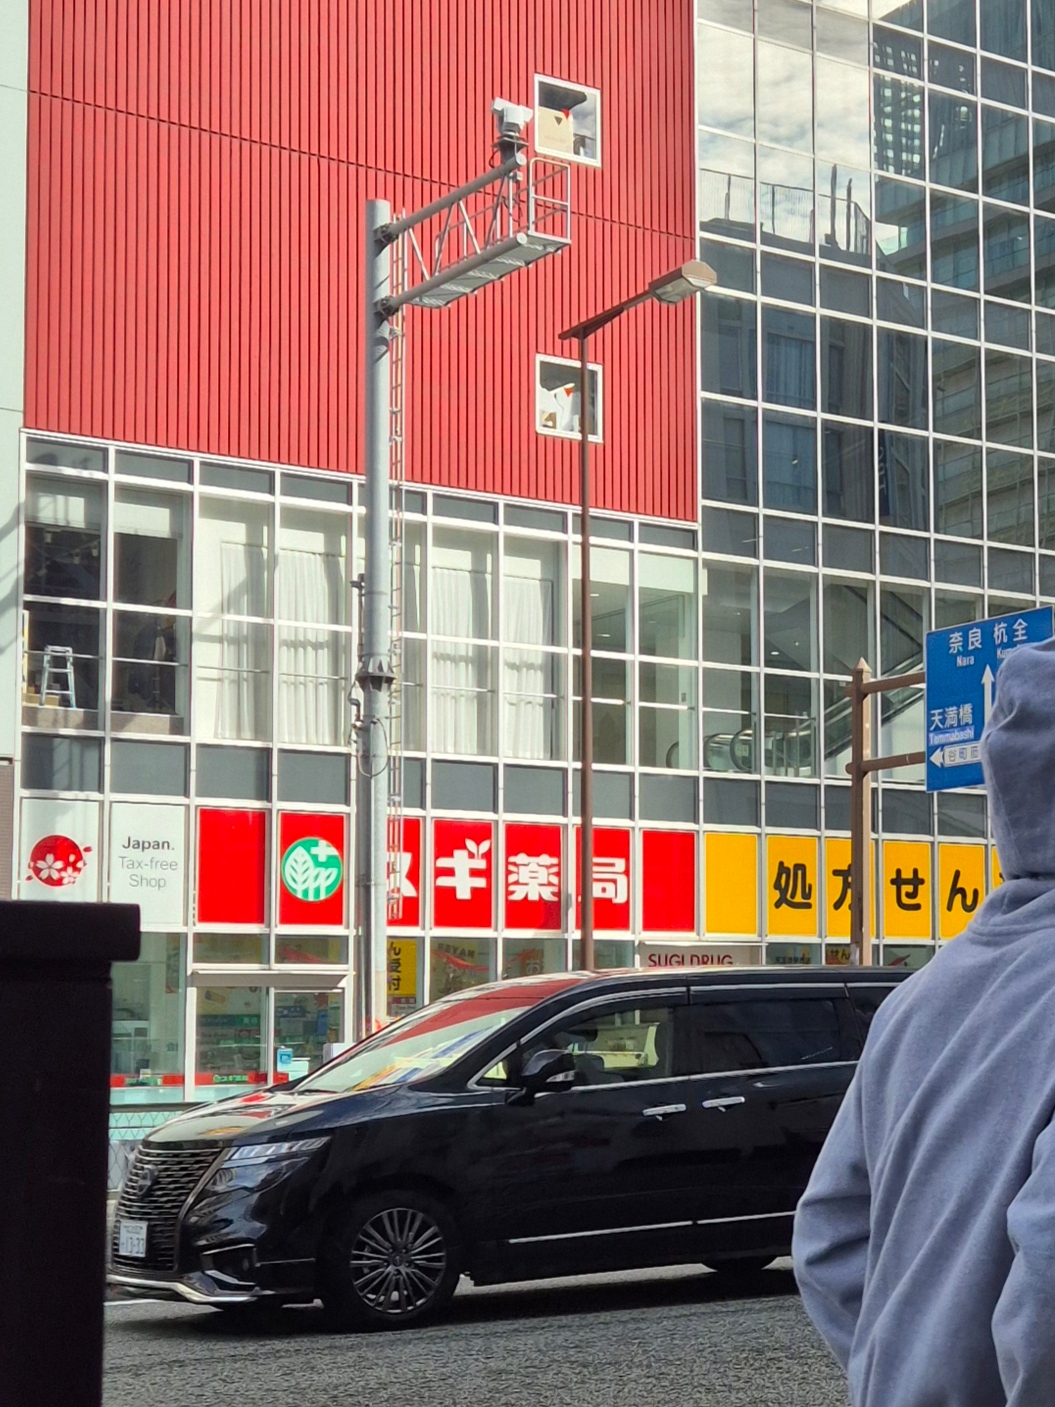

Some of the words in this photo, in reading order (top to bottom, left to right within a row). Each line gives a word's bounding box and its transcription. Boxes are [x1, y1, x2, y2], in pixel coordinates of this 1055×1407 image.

[949, 627, 982, 654] 奈良
[993, 618, 1028, 645] 杭全
[956, 655, 975, 668] Nara
[929, 703, 973, 731] 天満橋
[122, 836, 175, 852] Japan.
[118, 856, 178, 871] Tax-free
[129, 874, 167, 891] Shop
[773, 860, 1005, 913] 処方せん
[648, 953, 685, 967] SUGI
